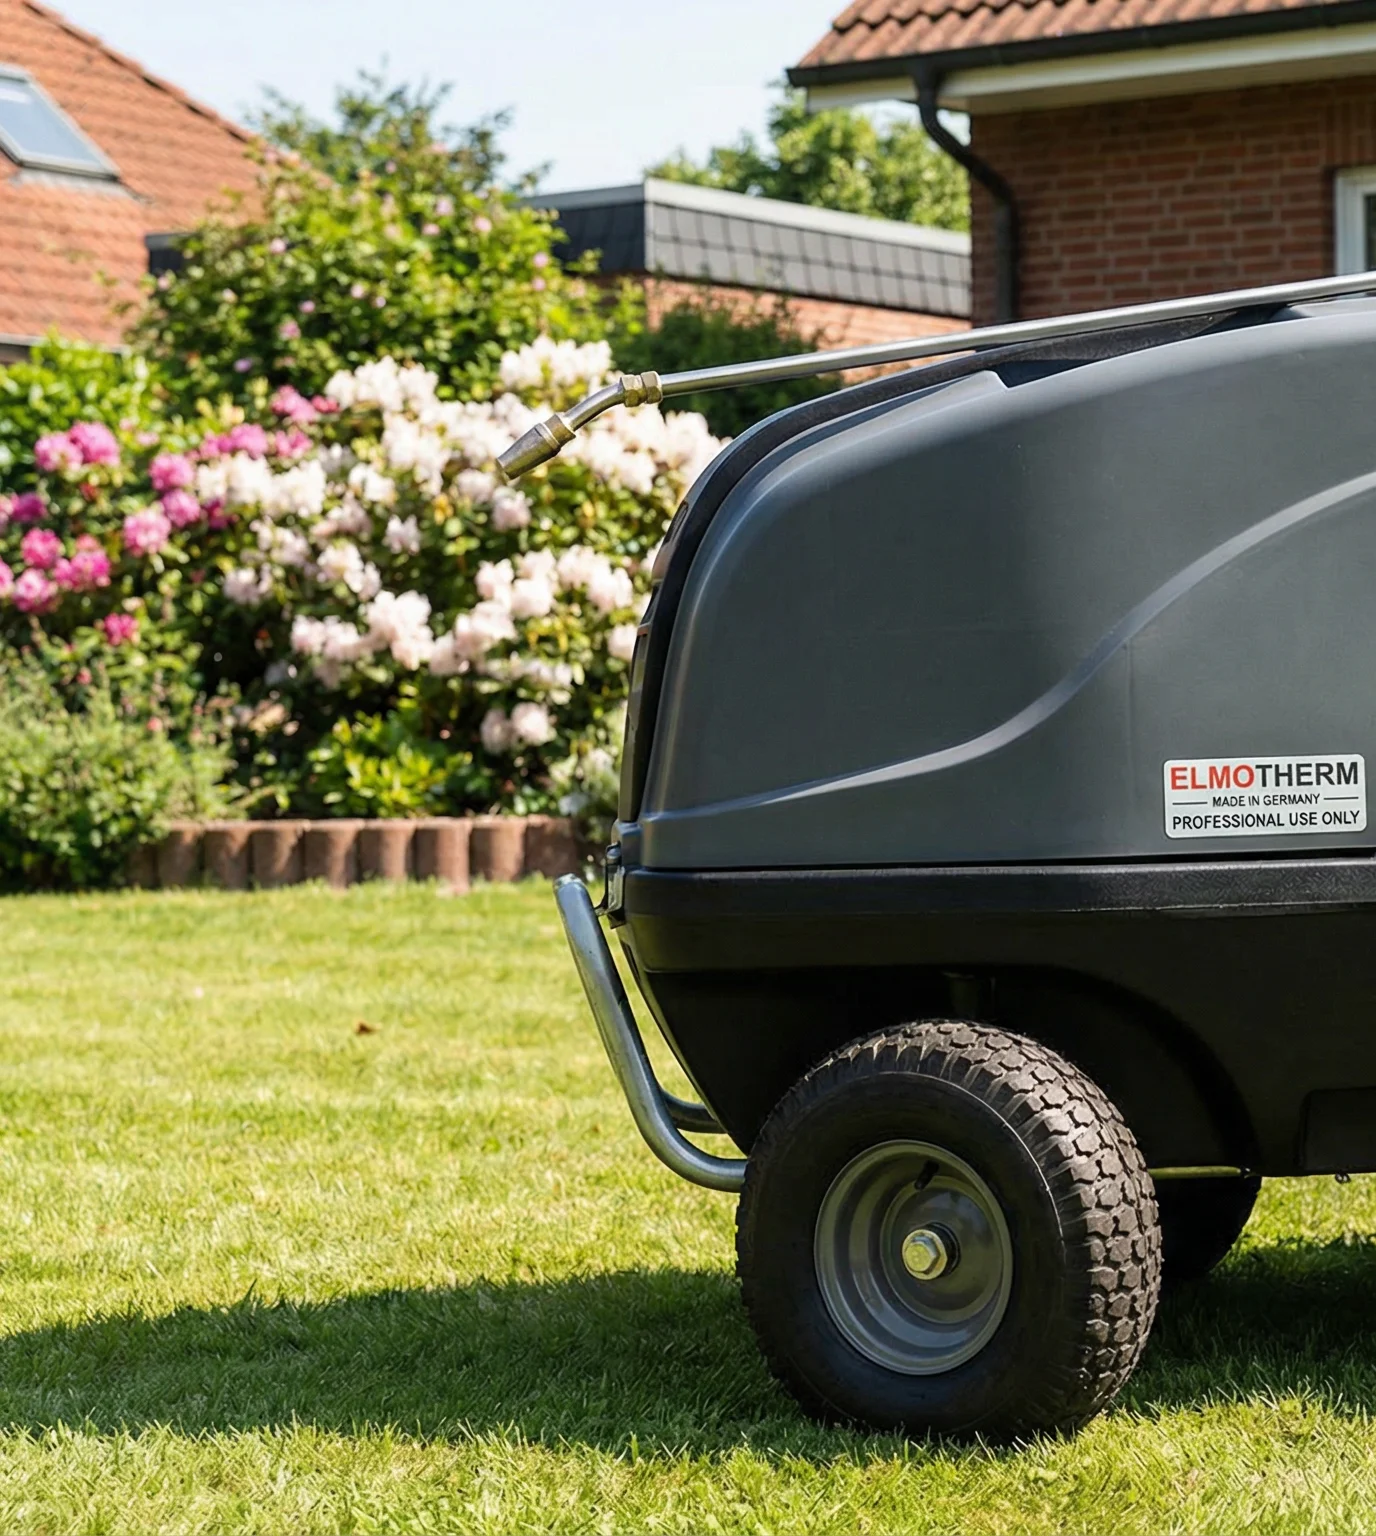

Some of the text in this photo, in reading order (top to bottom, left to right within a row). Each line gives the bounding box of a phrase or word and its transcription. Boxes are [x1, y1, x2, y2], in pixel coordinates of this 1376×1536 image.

[1169, 761, 1359, 790] ELMOTHERM
[1212, 793, 1321, 807] MADE IN GERMANY
[1172, 810, 1361, 830] PROFESSIONAL USE ONLY
